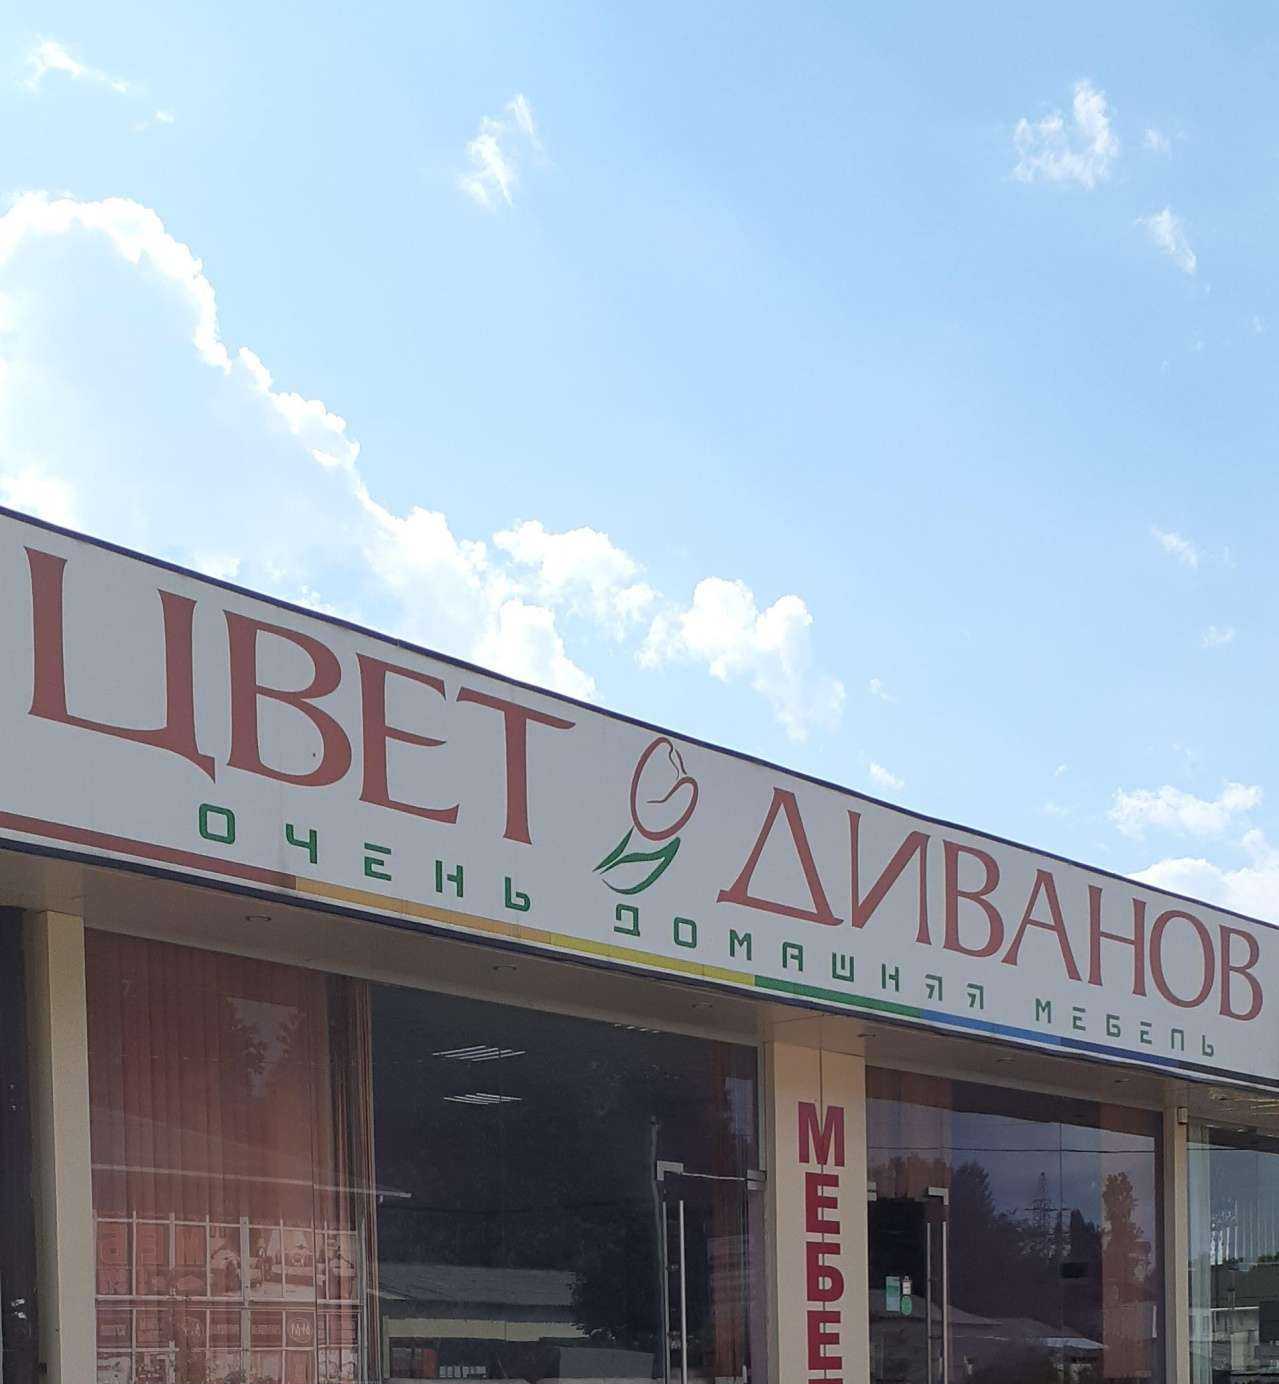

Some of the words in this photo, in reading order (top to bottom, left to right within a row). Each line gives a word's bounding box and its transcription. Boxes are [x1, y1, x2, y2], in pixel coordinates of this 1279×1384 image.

[24, 546, 576, 845] ЦВЕТ
[716, 787, 1264, 1021] ДИВАНОВ
[199, 803, 531, 912] ОЧЕНЬ
[613, 903, 985, 1010] ДОМАШНЯЯ
[1035, 998, 1215, 1057] МЕБЕЛЬ
